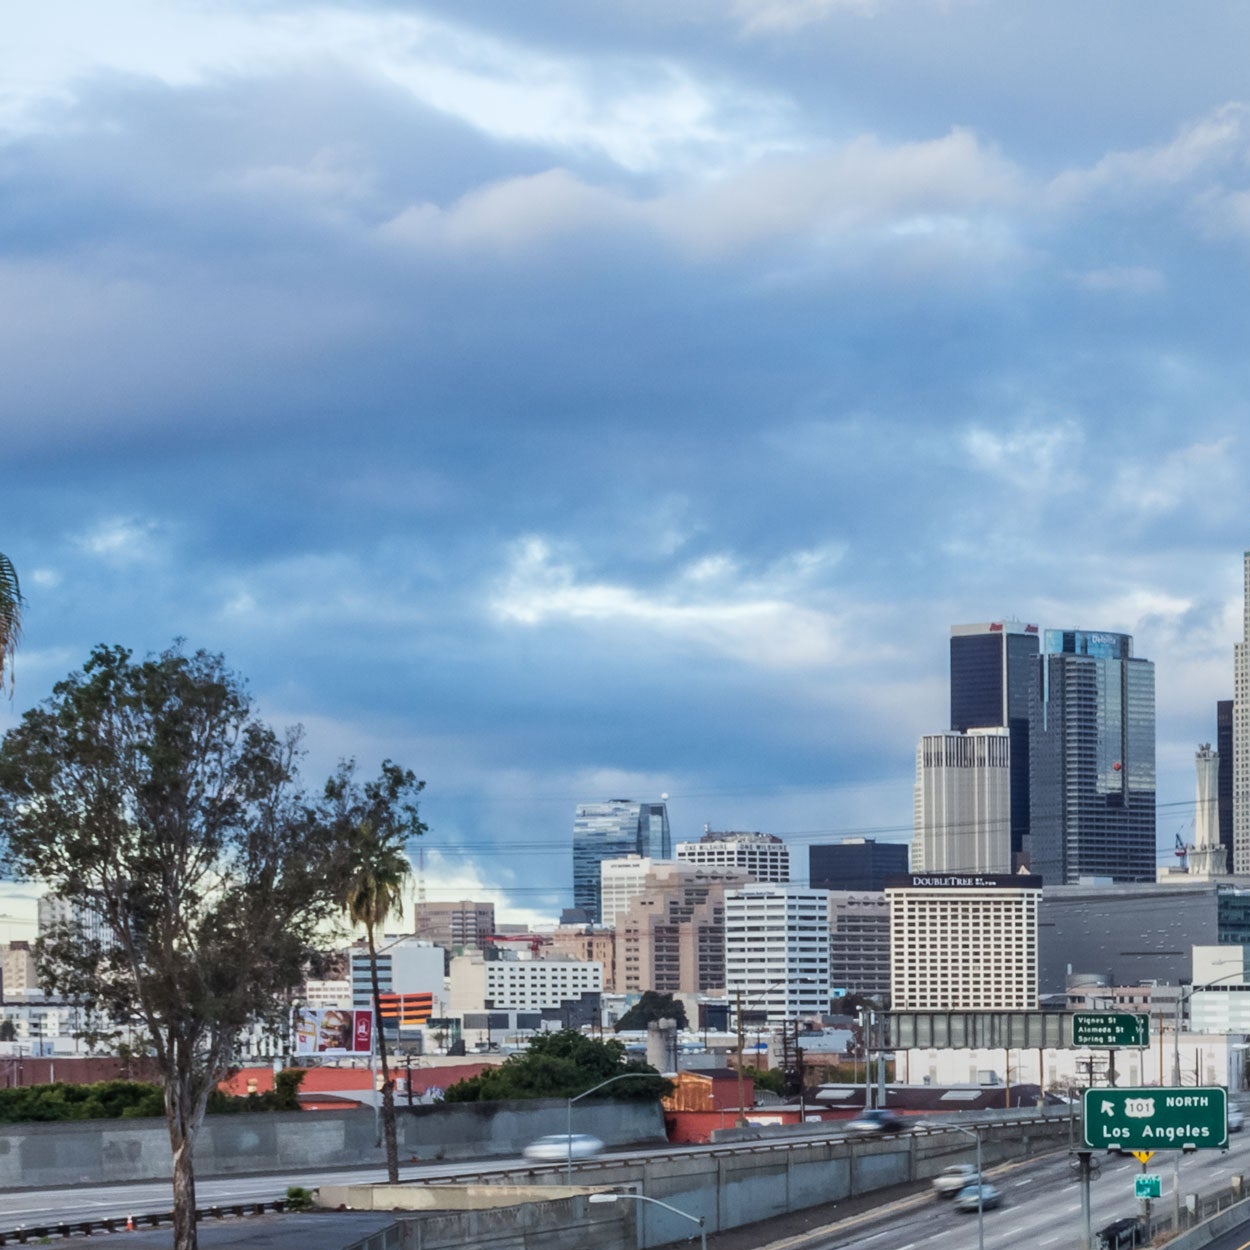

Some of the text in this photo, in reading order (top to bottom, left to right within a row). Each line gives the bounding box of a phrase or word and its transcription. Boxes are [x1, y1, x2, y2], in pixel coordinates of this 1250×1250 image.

[1078, 1017, 1104, 1025] Vignes
[1078, 1035, 1104, 1043] Spring
[1130, 1096, 1209, 1112] 101 NORTH
[1103, 1124, 1210, 1141] Los Angeles
